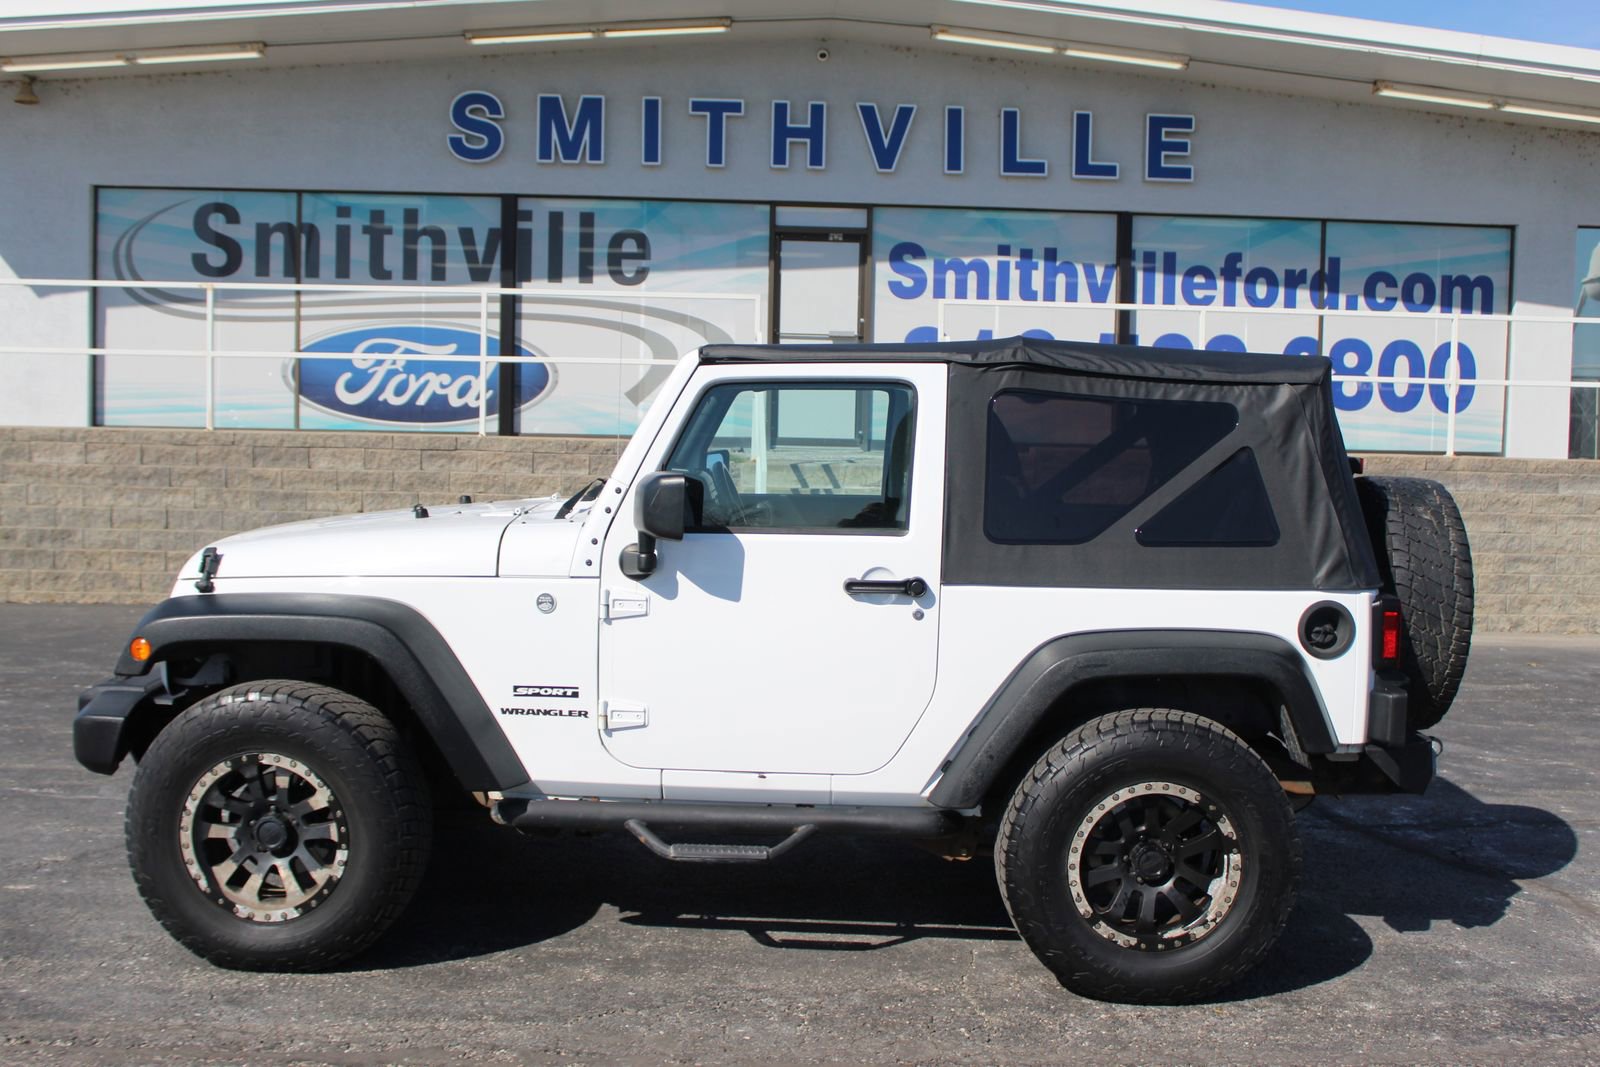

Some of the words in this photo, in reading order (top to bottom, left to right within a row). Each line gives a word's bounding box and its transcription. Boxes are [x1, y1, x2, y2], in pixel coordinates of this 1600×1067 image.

[447, 91, 1195, 181] SMITHVILLE
[190, 201, 652, 286] Smithville
[335, 337, 495, 409] Ford
[500, 707, 589, 718] WRANGLER
[515, 687, 576, 696] SPORT
